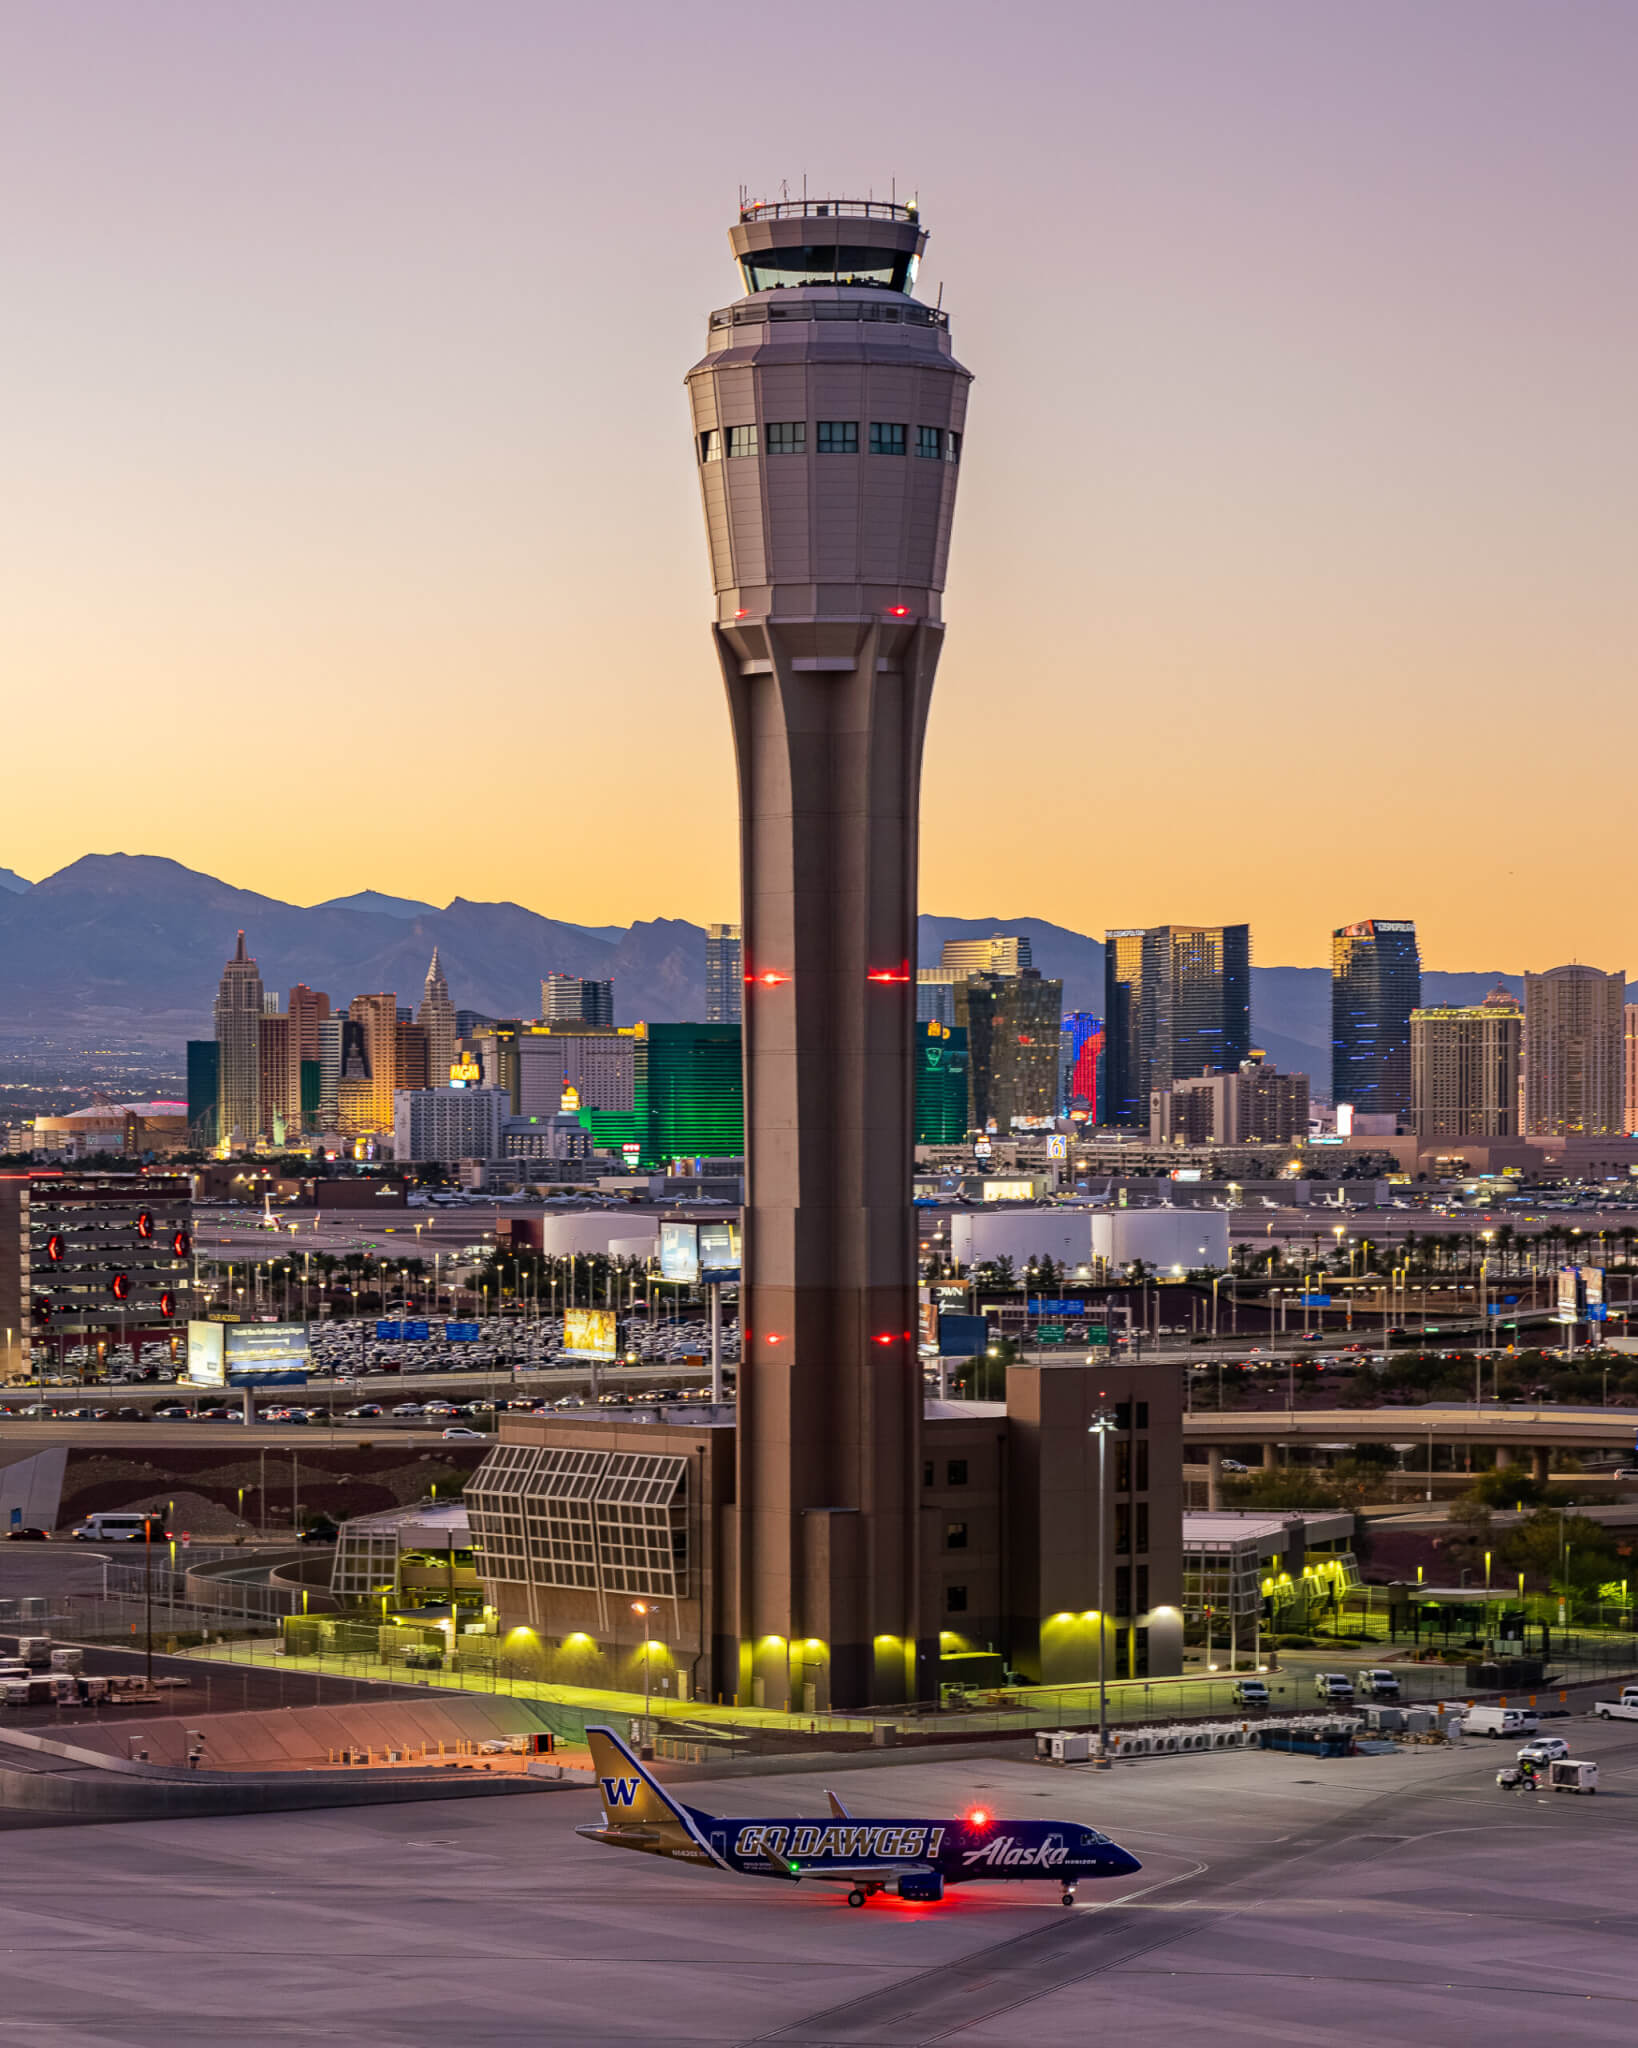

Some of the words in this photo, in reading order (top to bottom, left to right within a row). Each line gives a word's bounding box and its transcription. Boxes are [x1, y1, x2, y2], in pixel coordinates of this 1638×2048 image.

[450, 1063, 480, 1080] MGM
[1051, 1135, 1063, 1157] 6
[600, 1776, 641, 1807] W
[735, 1826, 789, 1857] GO
[787, 1827, 945, 1858] DAWGS!
[962, 1835, 1070, 1868] Alaska
